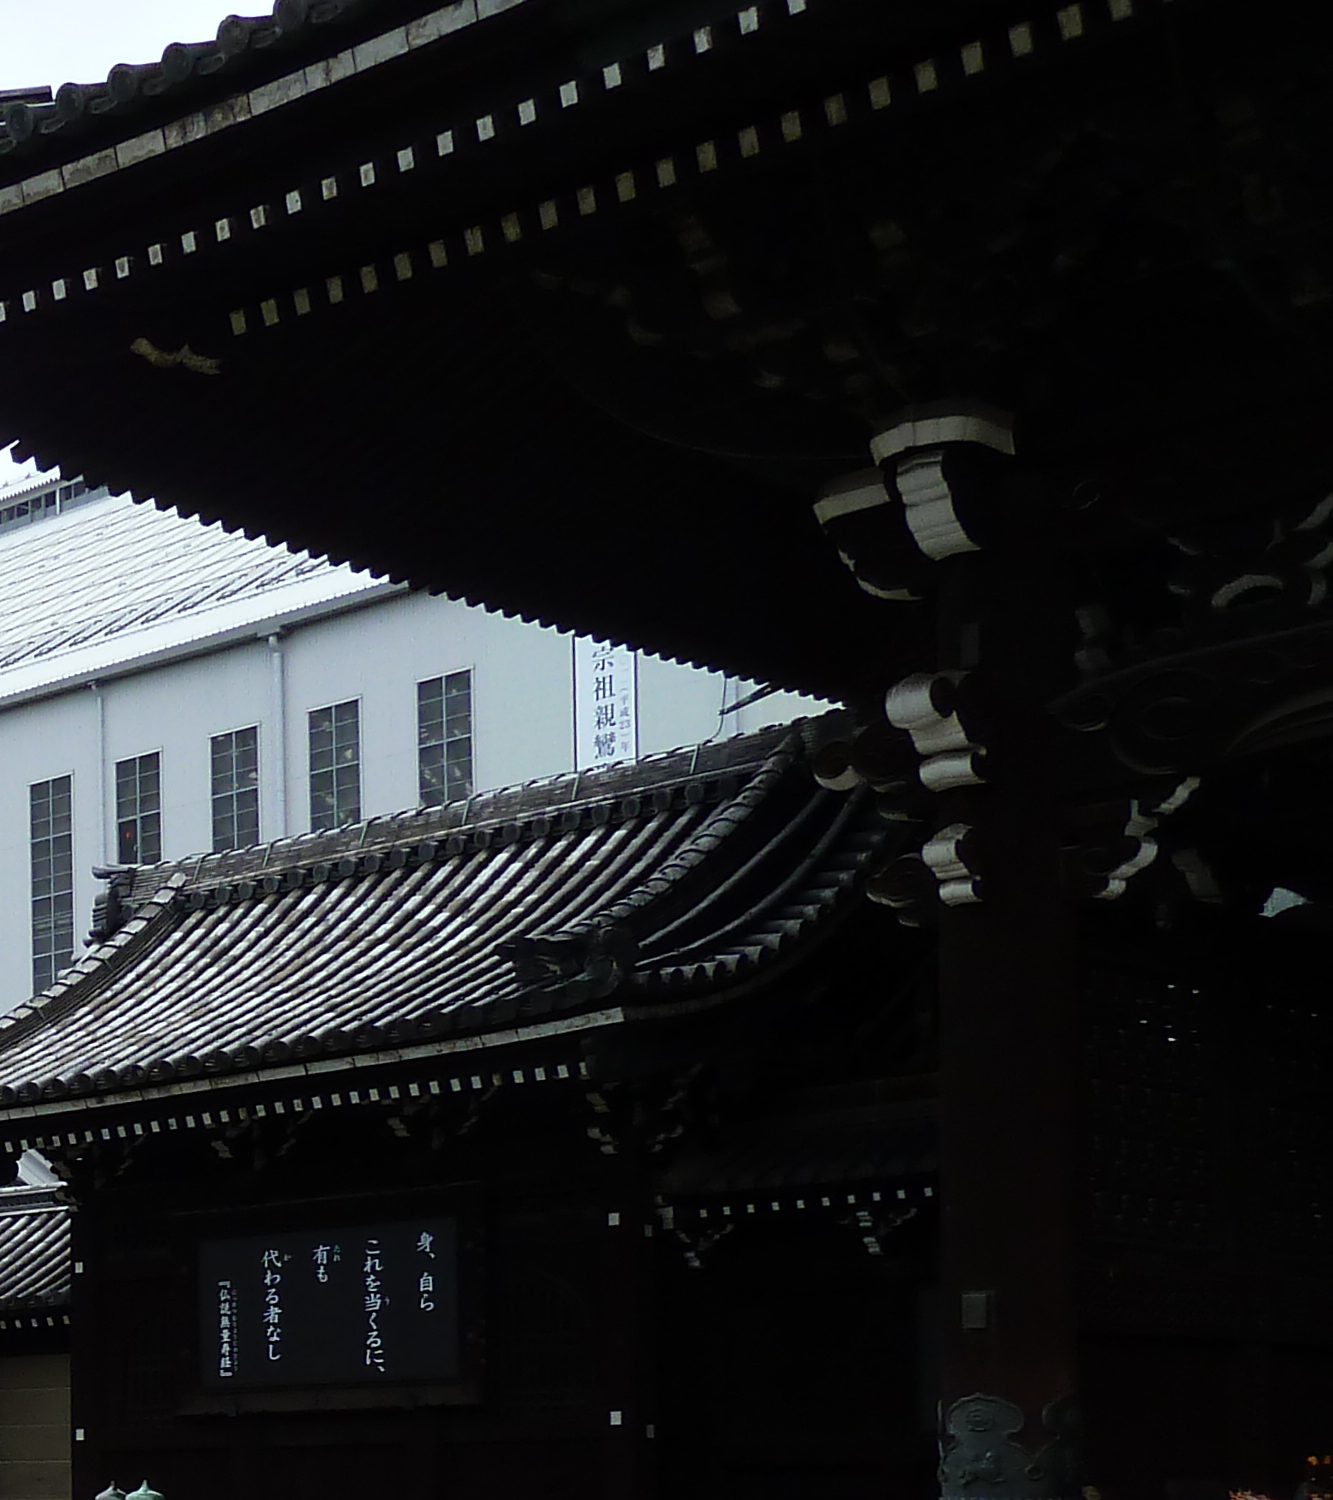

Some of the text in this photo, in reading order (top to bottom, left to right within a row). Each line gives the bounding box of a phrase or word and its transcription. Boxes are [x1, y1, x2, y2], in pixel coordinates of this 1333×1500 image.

[592, 645, 617, 768] 宗祖親鸞
[261, 1250, 282, 1360] 代わる者なし
[313, 1244, 331, 1282] 有も
